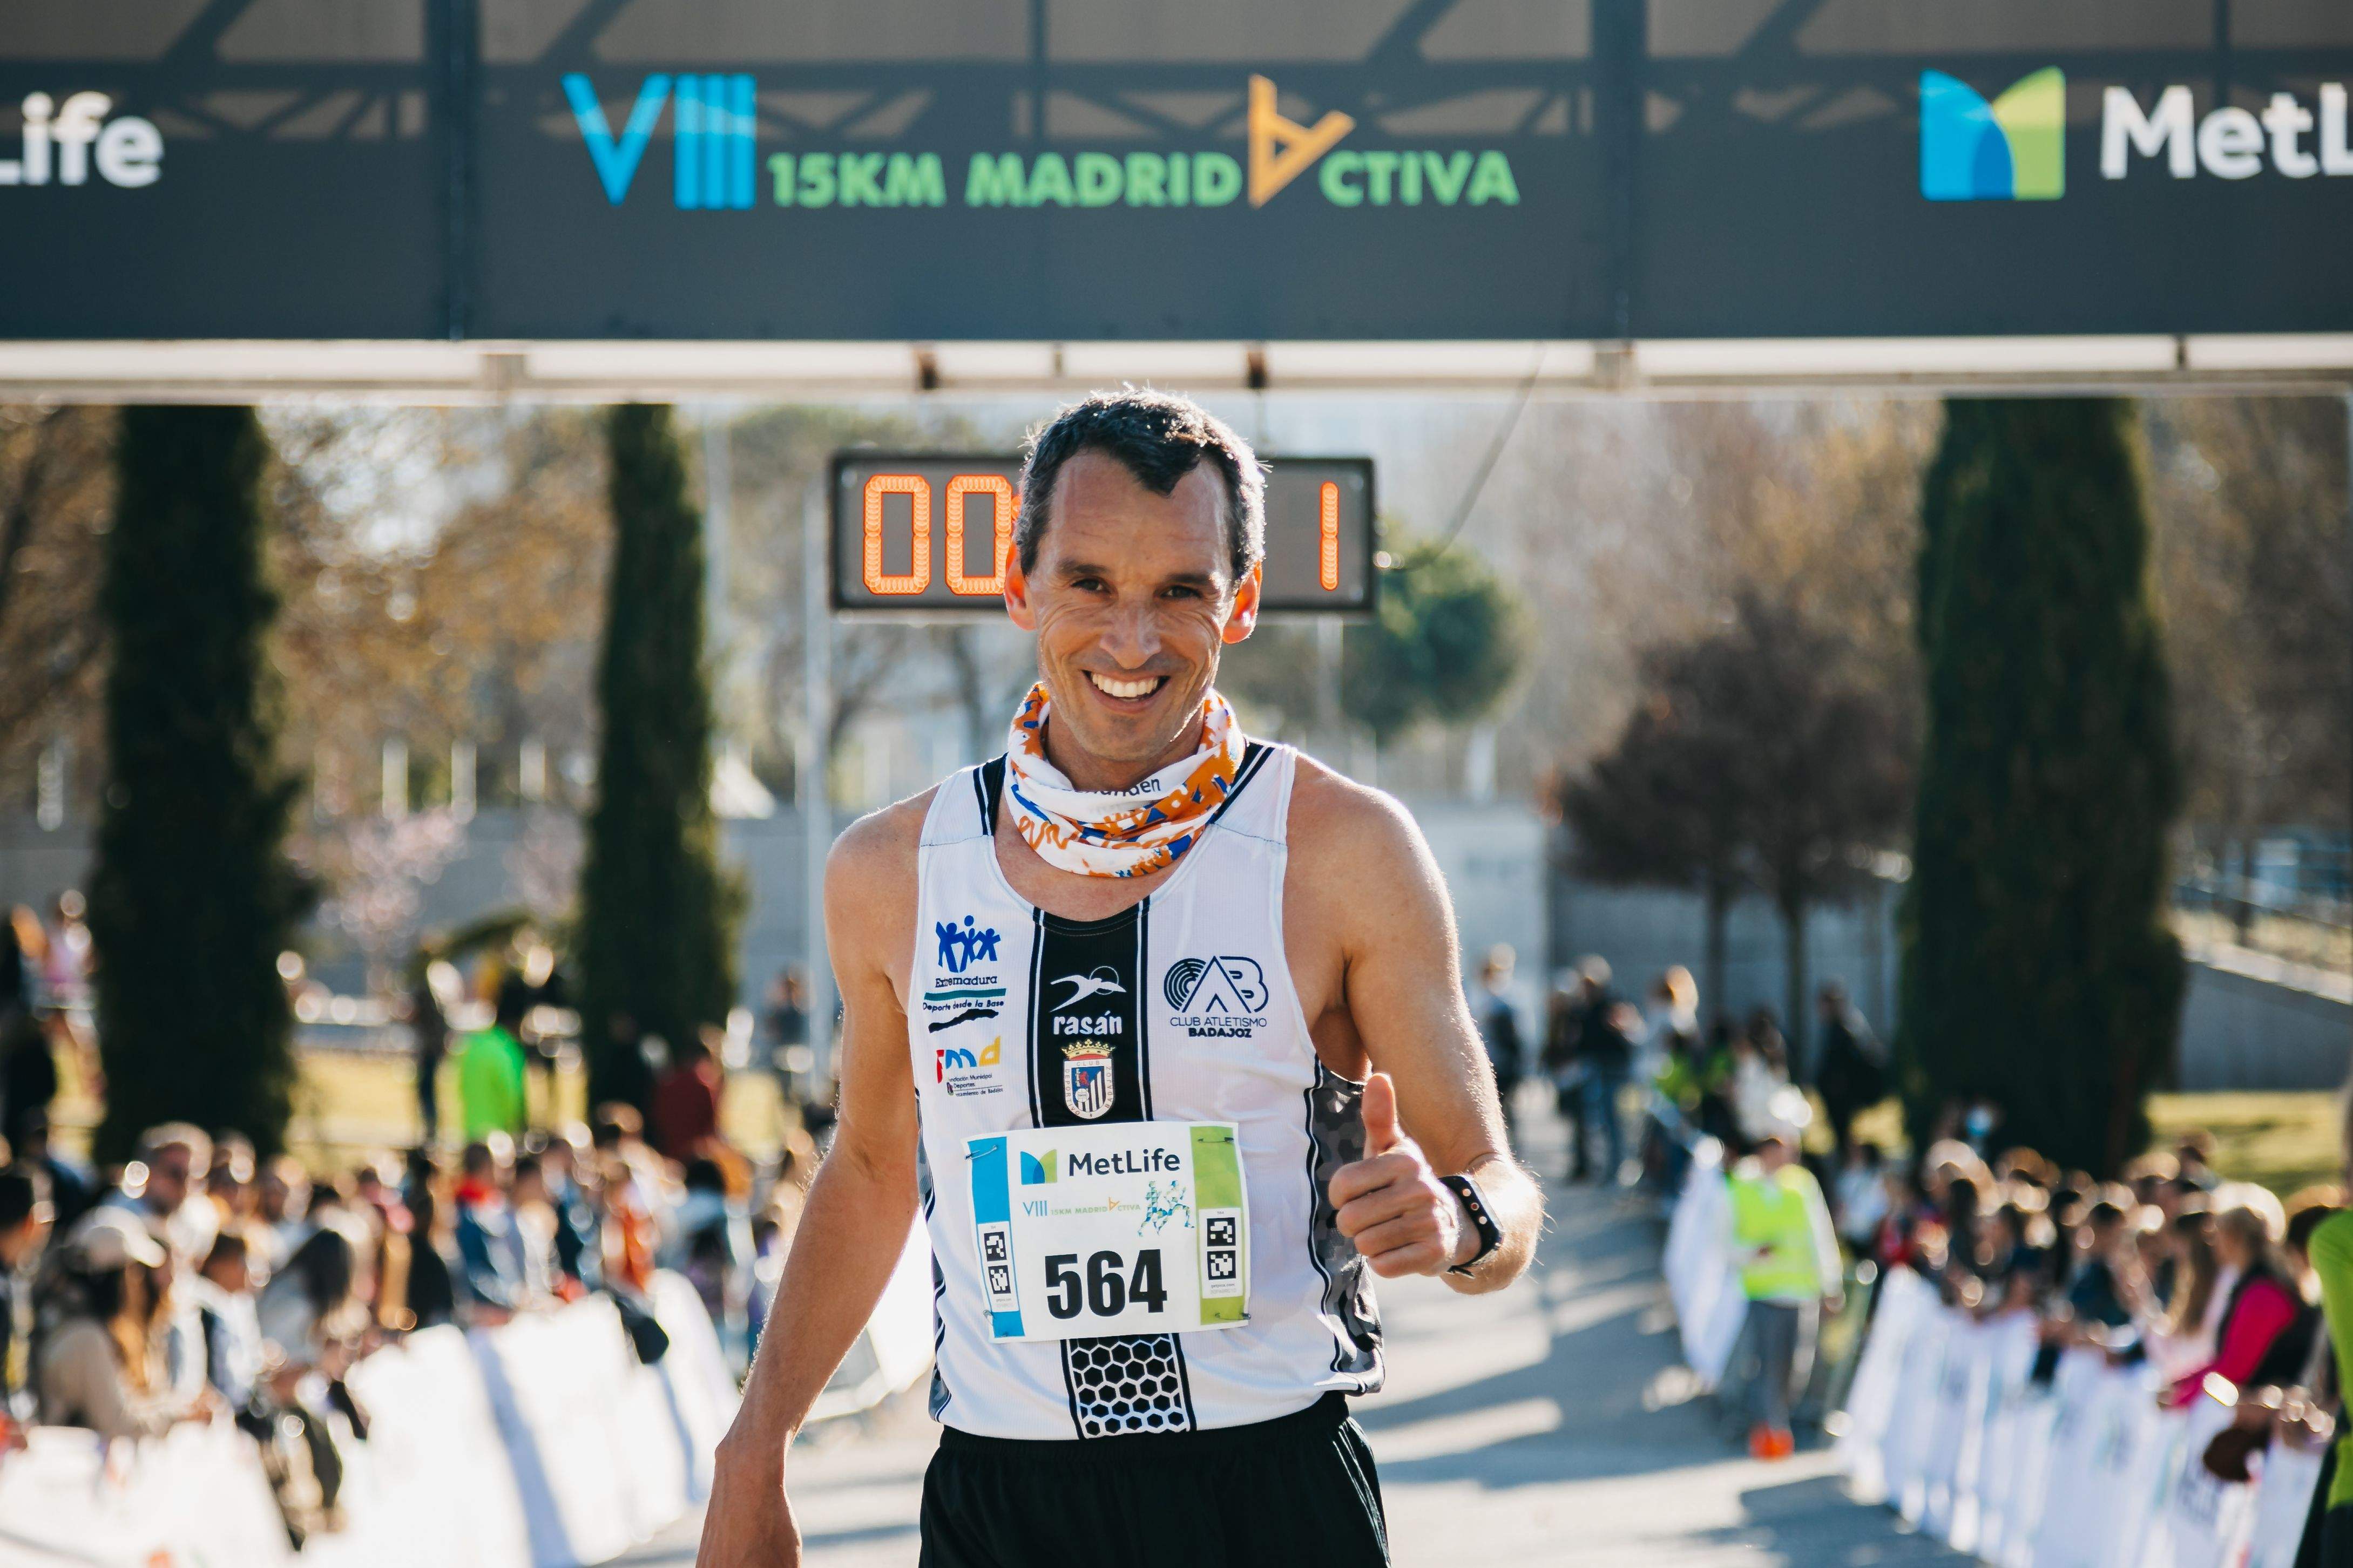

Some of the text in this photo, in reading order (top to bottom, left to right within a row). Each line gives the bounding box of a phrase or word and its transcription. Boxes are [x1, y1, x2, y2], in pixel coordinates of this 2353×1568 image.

[560, 72, 756, 209] VIII
[767, 152, 946, 208] 15KM
[923, 1002, 951, 1013] Deporte
[953, 999, 972, 1009] desde
[986, 999, 1004, 1007] Base
[1053, 1010, 1123, 1035] rasán
[1170, 1017, 1267, 1027] CLUB ATLETISMO
[1188, 1027, 1252, 1038] BADAJOZ
[1065, 1069, 1080, 1115] DEPORTIVO
[1068, 1148, 1181, 1177] MetLife
[1023, 1199, 1048, 1217] VIII
[1044, 1248, 1168, 1320] 564
